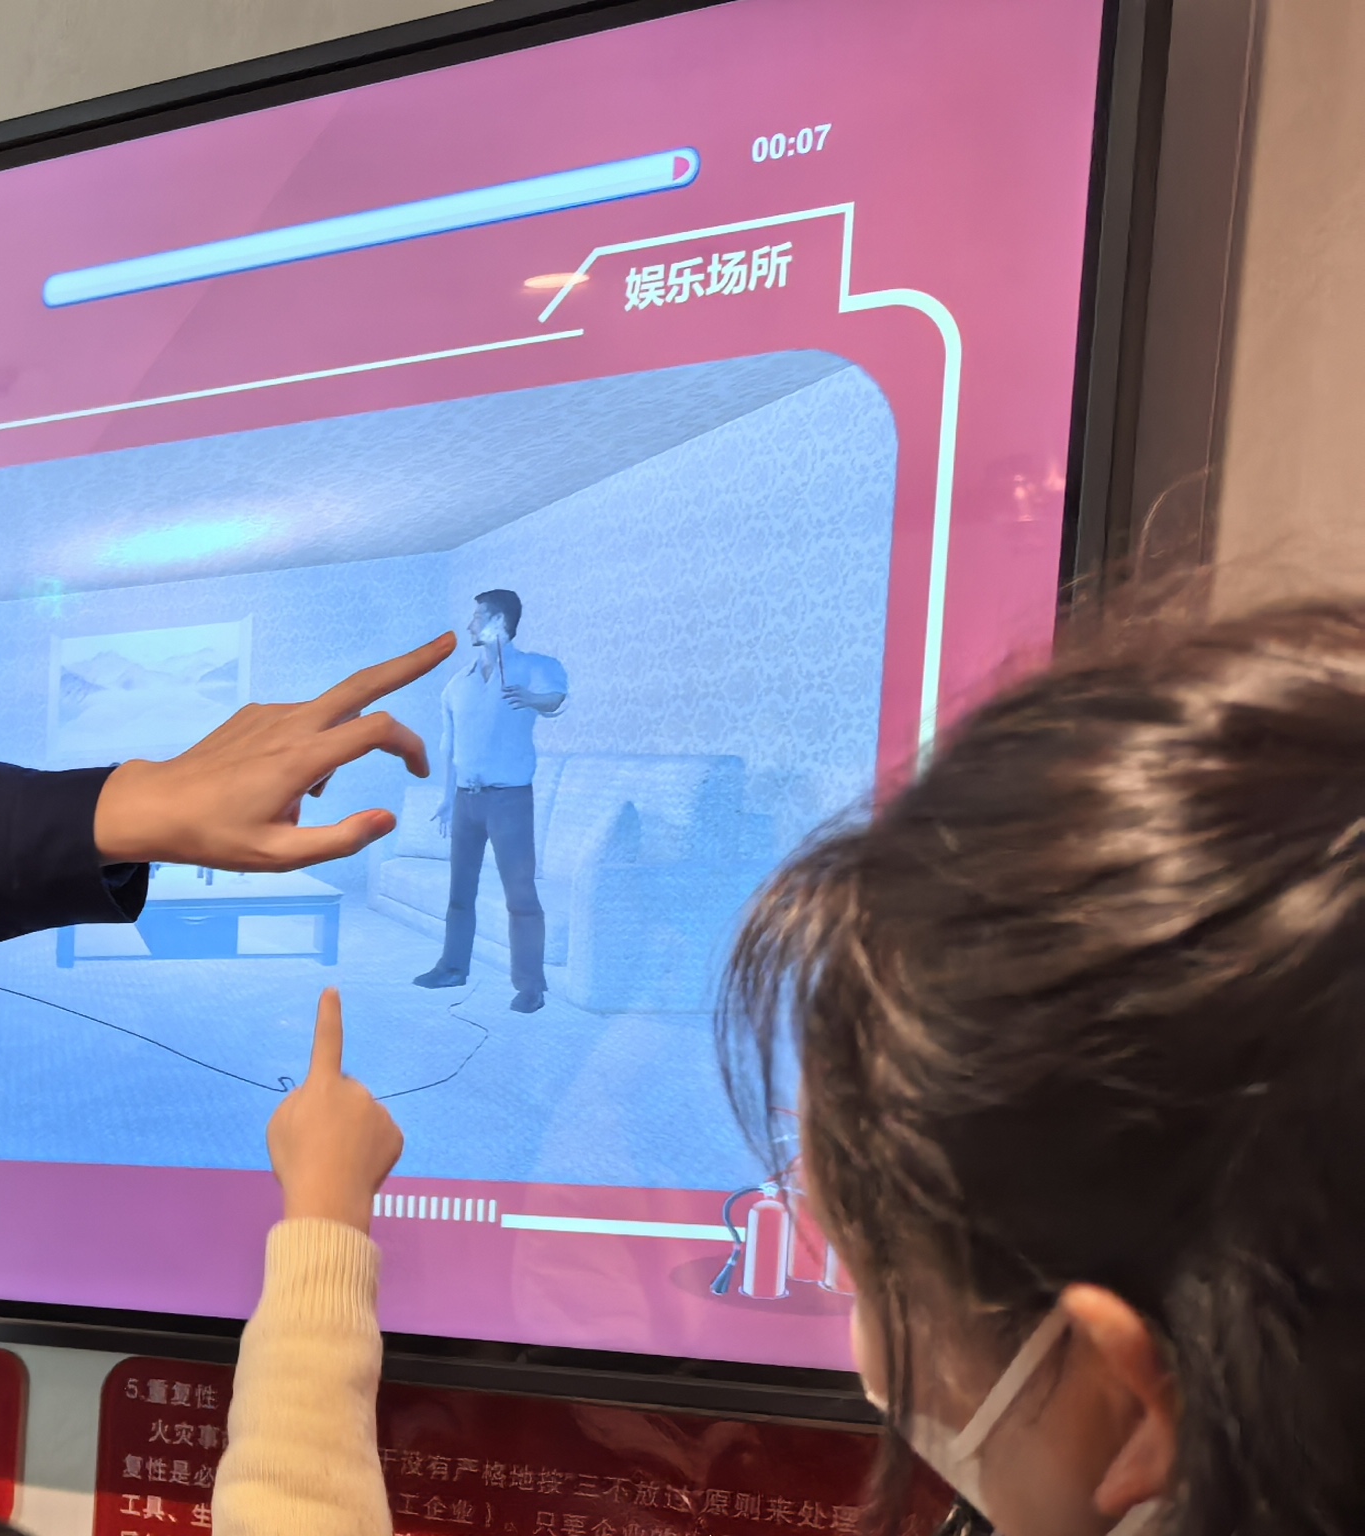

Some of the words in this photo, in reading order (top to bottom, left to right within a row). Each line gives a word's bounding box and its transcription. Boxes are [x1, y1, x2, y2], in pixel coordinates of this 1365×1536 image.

[751, 123, 832, 163] 00:07
[624, 241, 793, 311] 娱乐场所
[125, 1378, 218, 1410] 5.重复性
